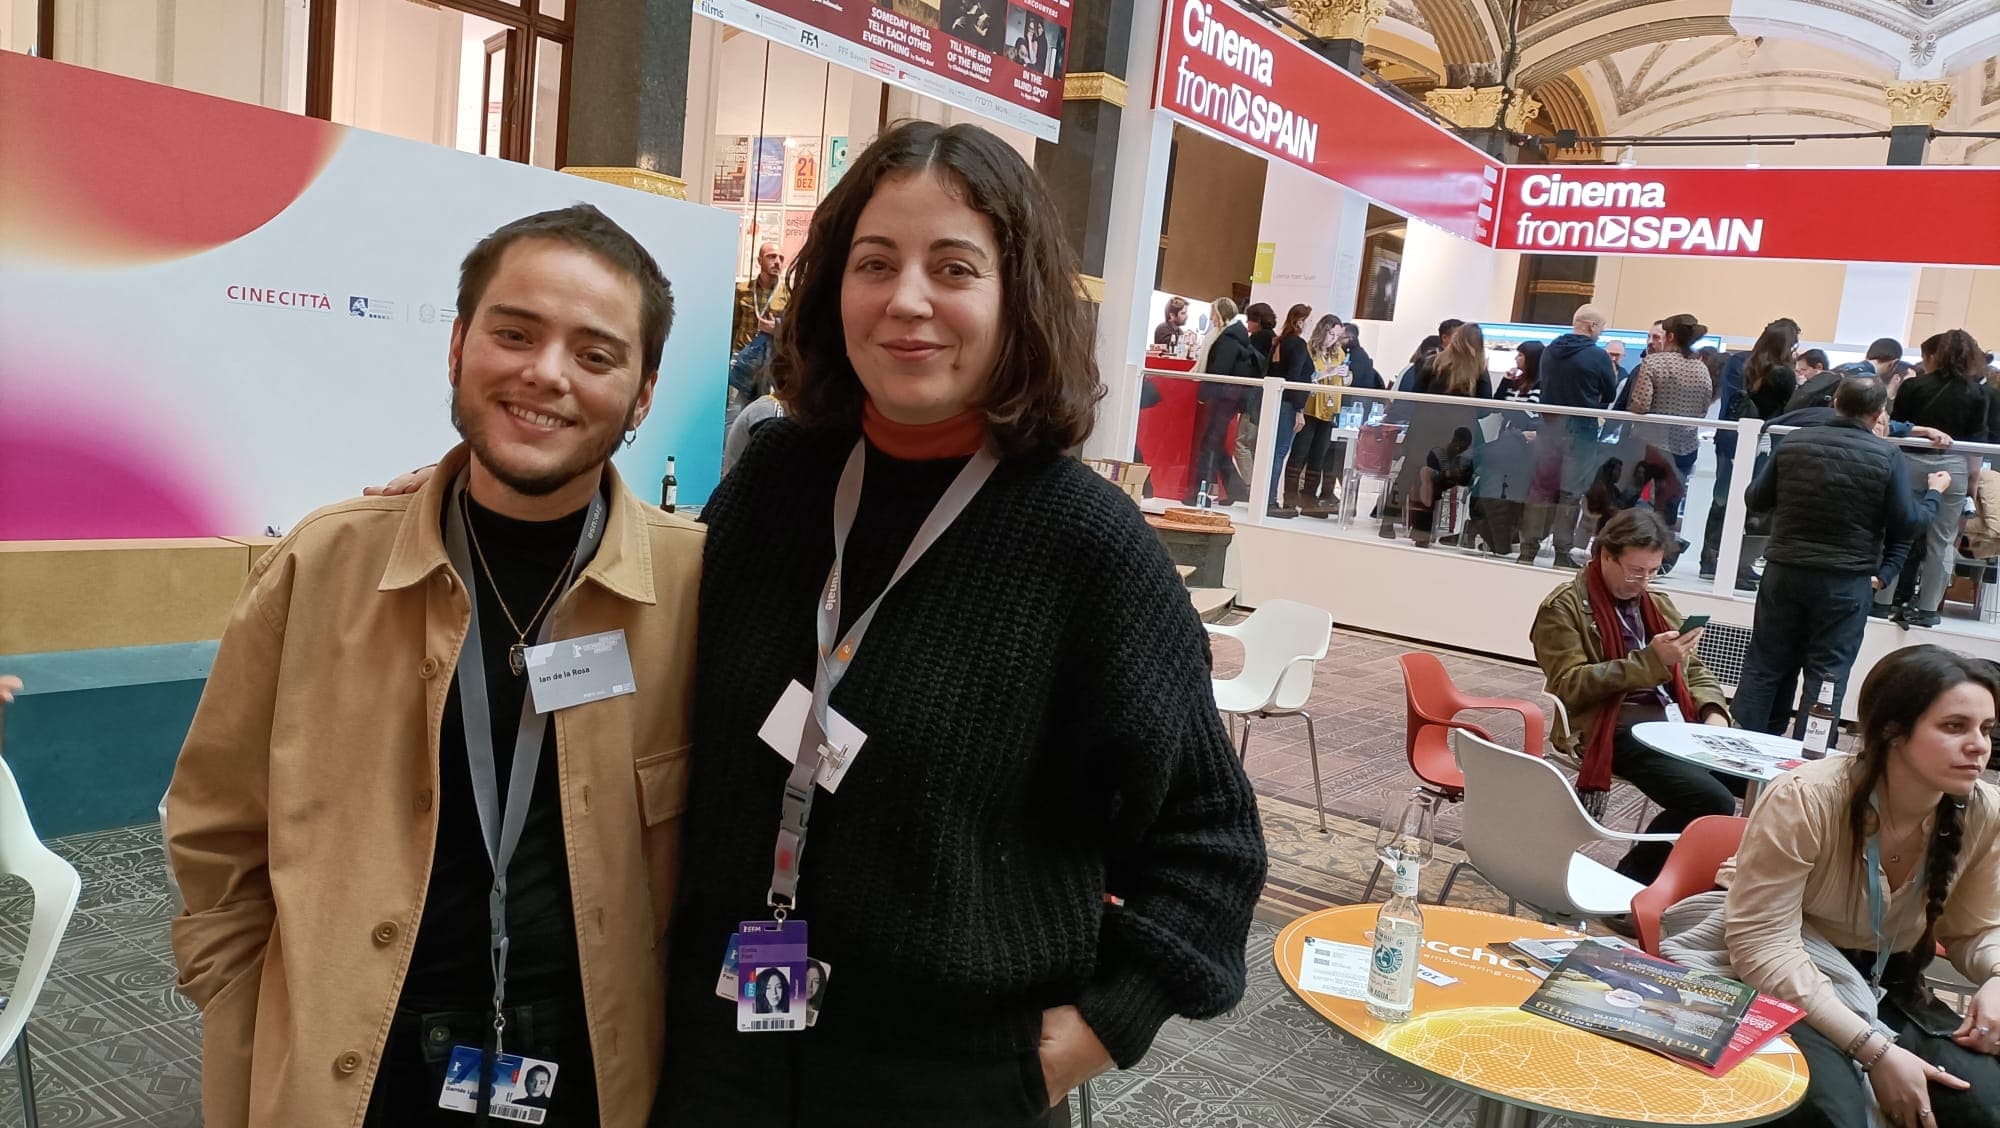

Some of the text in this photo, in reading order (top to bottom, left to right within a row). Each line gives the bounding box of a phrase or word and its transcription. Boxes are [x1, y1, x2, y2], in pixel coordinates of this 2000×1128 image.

[701, 2, 724, 18] films
[871, 7, 930, 39] SOMEDAY WE'LL
[862, 30, 910, 58] EVERYTHING
[868, 18, 932, 53] TELL EACH OTHER
[1182, 0, 1274, 87] Cinema
[947, 51, 957, 62] OF
[958, 57, 972, 69] THE
[971, 61, 993, 77] NIGHT
[949, 39, 992, 65] TILL THE END
[1013, 78, 1033, 94] BLIND
[1032, 85, 1049, 99] SPOT
[1022, 69, 1043, 86] IN THE
[1175, 55, 1319, 164] from SPAIN
[797, 158, 814, 177] 21
[796, 178, 813, 189] DEZ
[1520, 173, 1666, 208] Cinema
[1516, 213, 1594, 247] from
[1630, 215, 1764, 252] SPAIN
[226, 285, 332, 310] CINECITTÀ
[553, 672, 562, 681] de
[564, 670, 571, 678] la
[572, 667, 590, 676] Rosa
[1424, 953, 1502, 977] empowering
